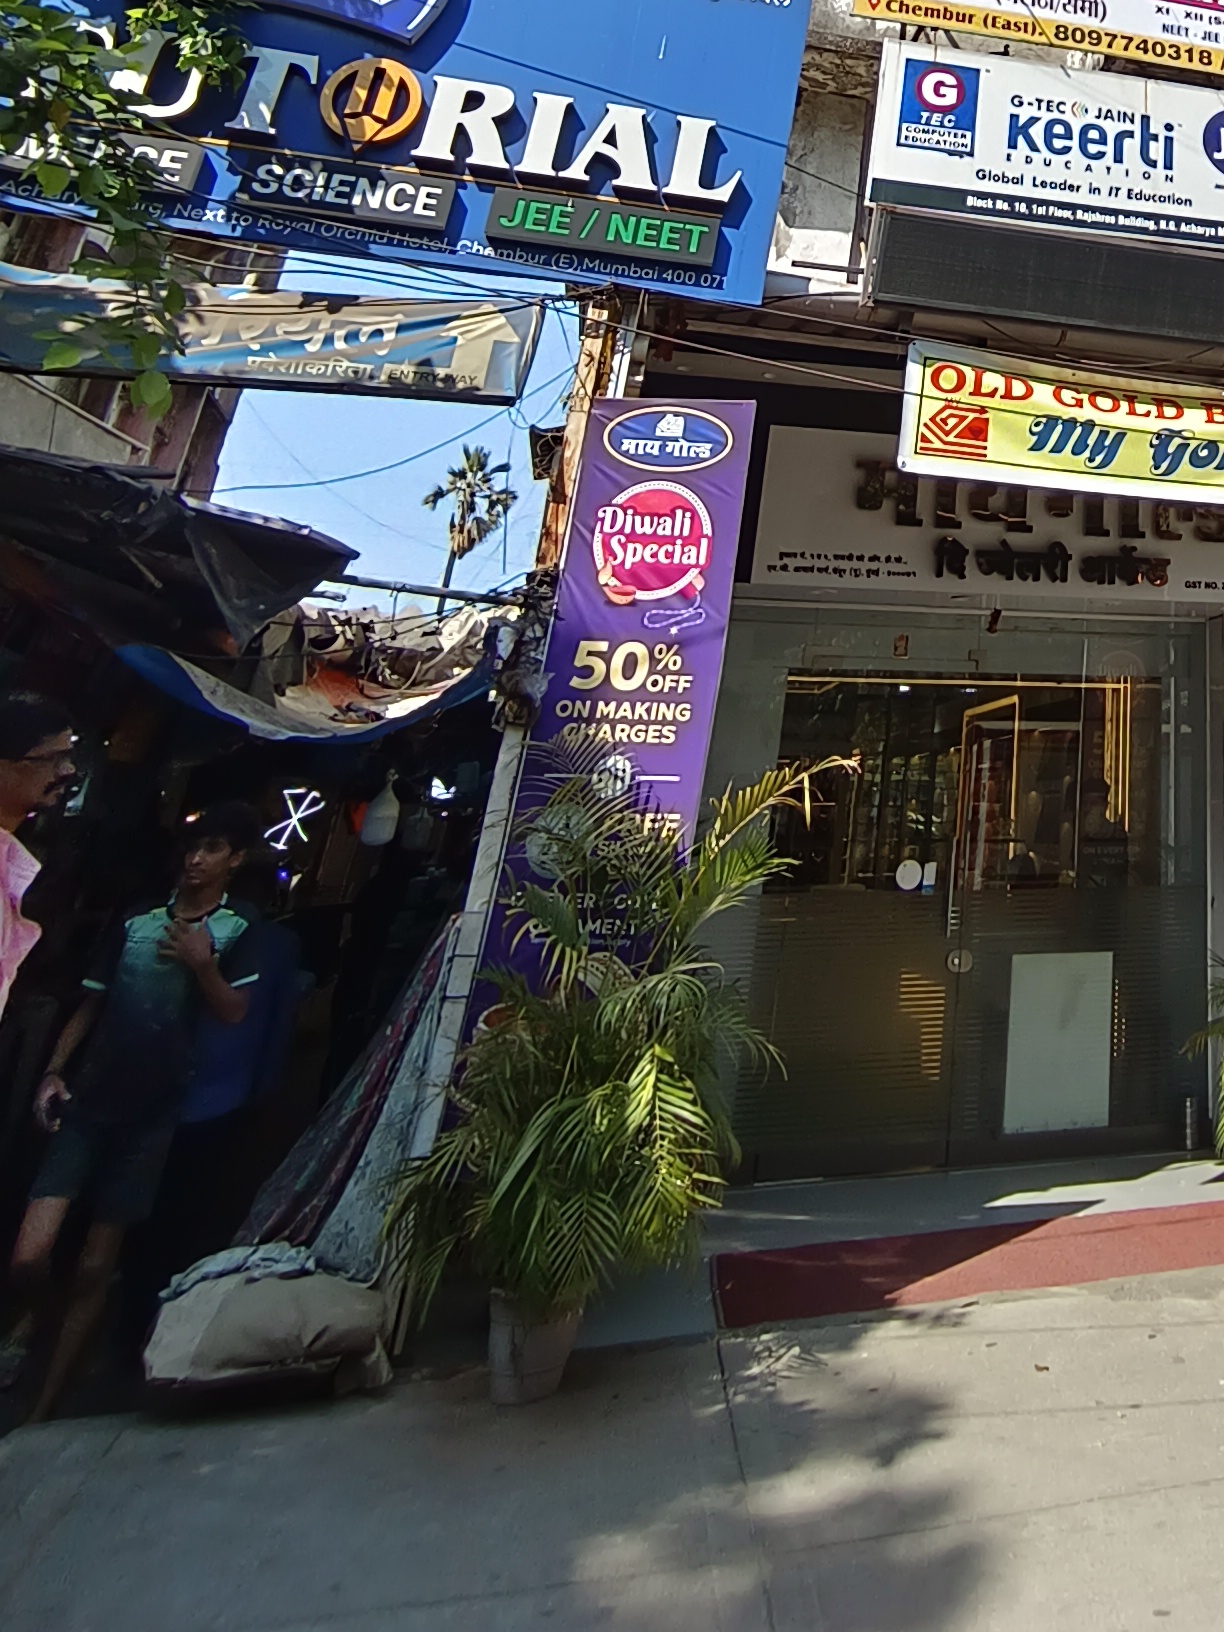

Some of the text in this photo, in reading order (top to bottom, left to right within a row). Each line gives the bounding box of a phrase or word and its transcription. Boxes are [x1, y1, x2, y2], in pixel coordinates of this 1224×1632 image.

[1053, 23, 1213, 67] 8097740318
[919, 112, 957, 128] TEC
[1010, 94, 1136, 124] G-TEC JAIN
[904, 135, 969, 151] EDUCATION
[905, 125, 968, 141] COMPUTER
[1005, 153, 1175, 184] EDUCATION
[975, 168, 1024, 186] Global
[1032, 176, 1082, 194] Leader
[1088, 183, 1101, 196] in
[1108, 186, 1122, 198] IT
[1127, 189, 1193, 208] Education
[251, 162, 443, 218] SCIENCE
[499, 198, 576, 236] JEE
[605, 212, 710, 254] NEET
[173, 203, 227, 224] Next
[231, 210, 253, 227] to
[456, 239, 547, 266] Chembur
[662, 271, 696, 286] 400
[700, 274, 727, 289] 071
[930, 362, 1035, 401] OLD
[1053, 384, 1186, 421] GOLD
[621, 437, 714, 458] माय गोल्ड
[1028, 414, 1128, 470] My
[598, 506, 692, 537] Diwali
[609, 534, 709, 570] Special
[1184, 579, 1202, 590] GST
[646, 674, 694, 694] OFF
[555, 699, 692, 722] ON MAKING
